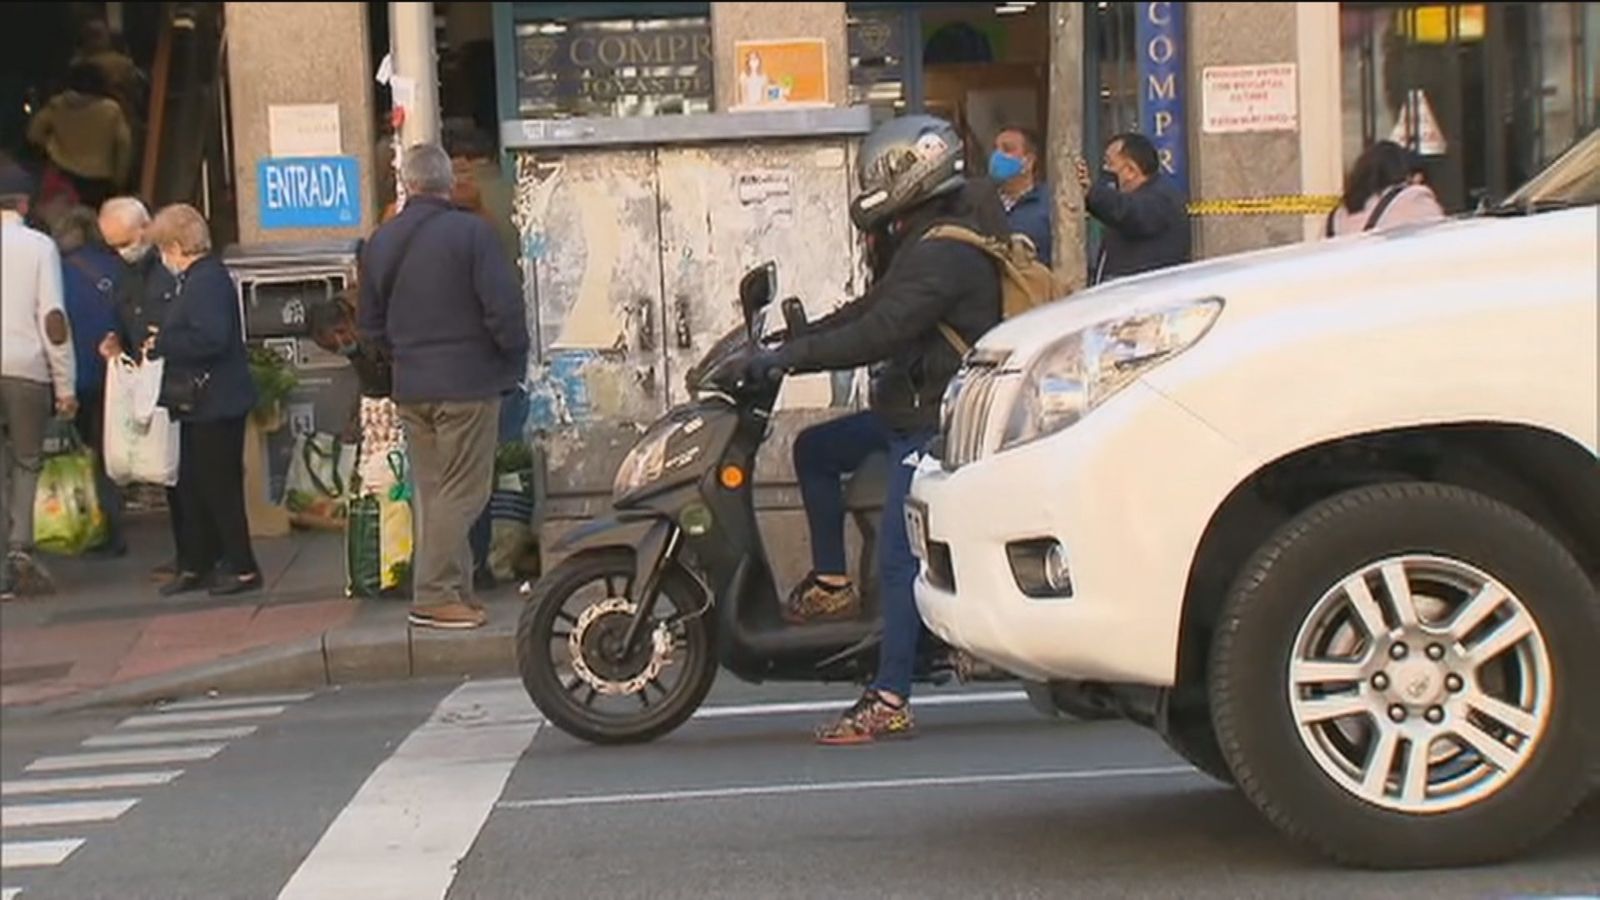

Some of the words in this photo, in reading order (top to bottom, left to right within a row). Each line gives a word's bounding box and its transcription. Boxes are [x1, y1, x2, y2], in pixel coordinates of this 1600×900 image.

[569, 34, 713, 67] COMPR
[1148, 2, 1176, 174] COMPR
[266, 164, 349, 208] ENTRADA
